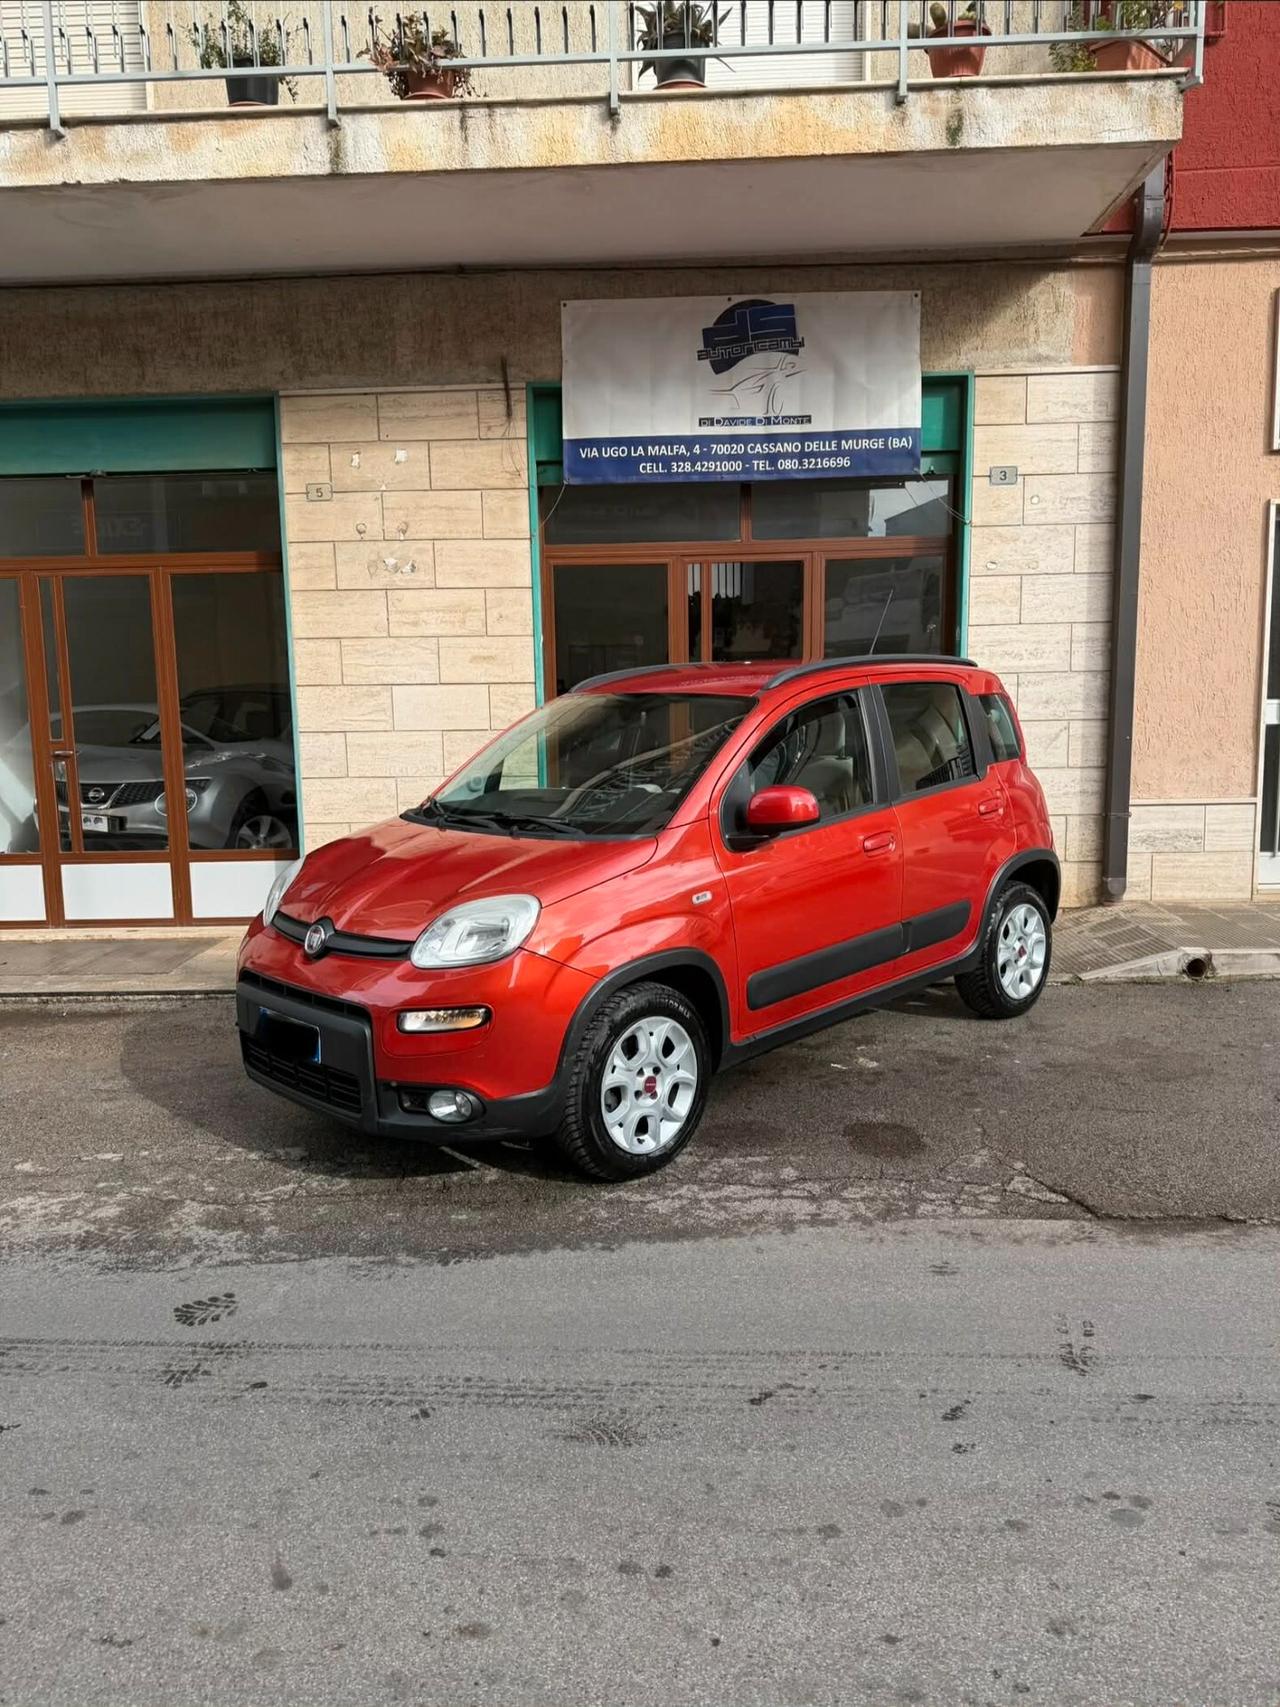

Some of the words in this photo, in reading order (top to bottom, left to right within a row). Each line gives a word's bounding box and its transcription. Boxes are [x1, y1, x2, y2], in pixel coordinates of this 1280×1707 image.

[579, 447, 599, 459] VIA
[602, 446, 627, 458] UGO
[631, 446, 643, 457] LA
[647, 445, 690, 457] MALFA,
[692, 444, 701, 455] 4
[710, 444, 745, 455] 70020
[747, 442, 802, 454] CASSANO
[804, 440, 838, 452] DELLE
[841, 438, 885, 450] MURGE
[888, 436, 913, 450] (BA)
[639, 462, 668, 474] CELL.
[671, 460, 743, 473] 328.4291000
[752, 460, 775, 471] TEL.
[777, 456, 851, 470] 080.3216696
[999, 470, 1008, 481] 3
[315, 487, 324, 498] 5
